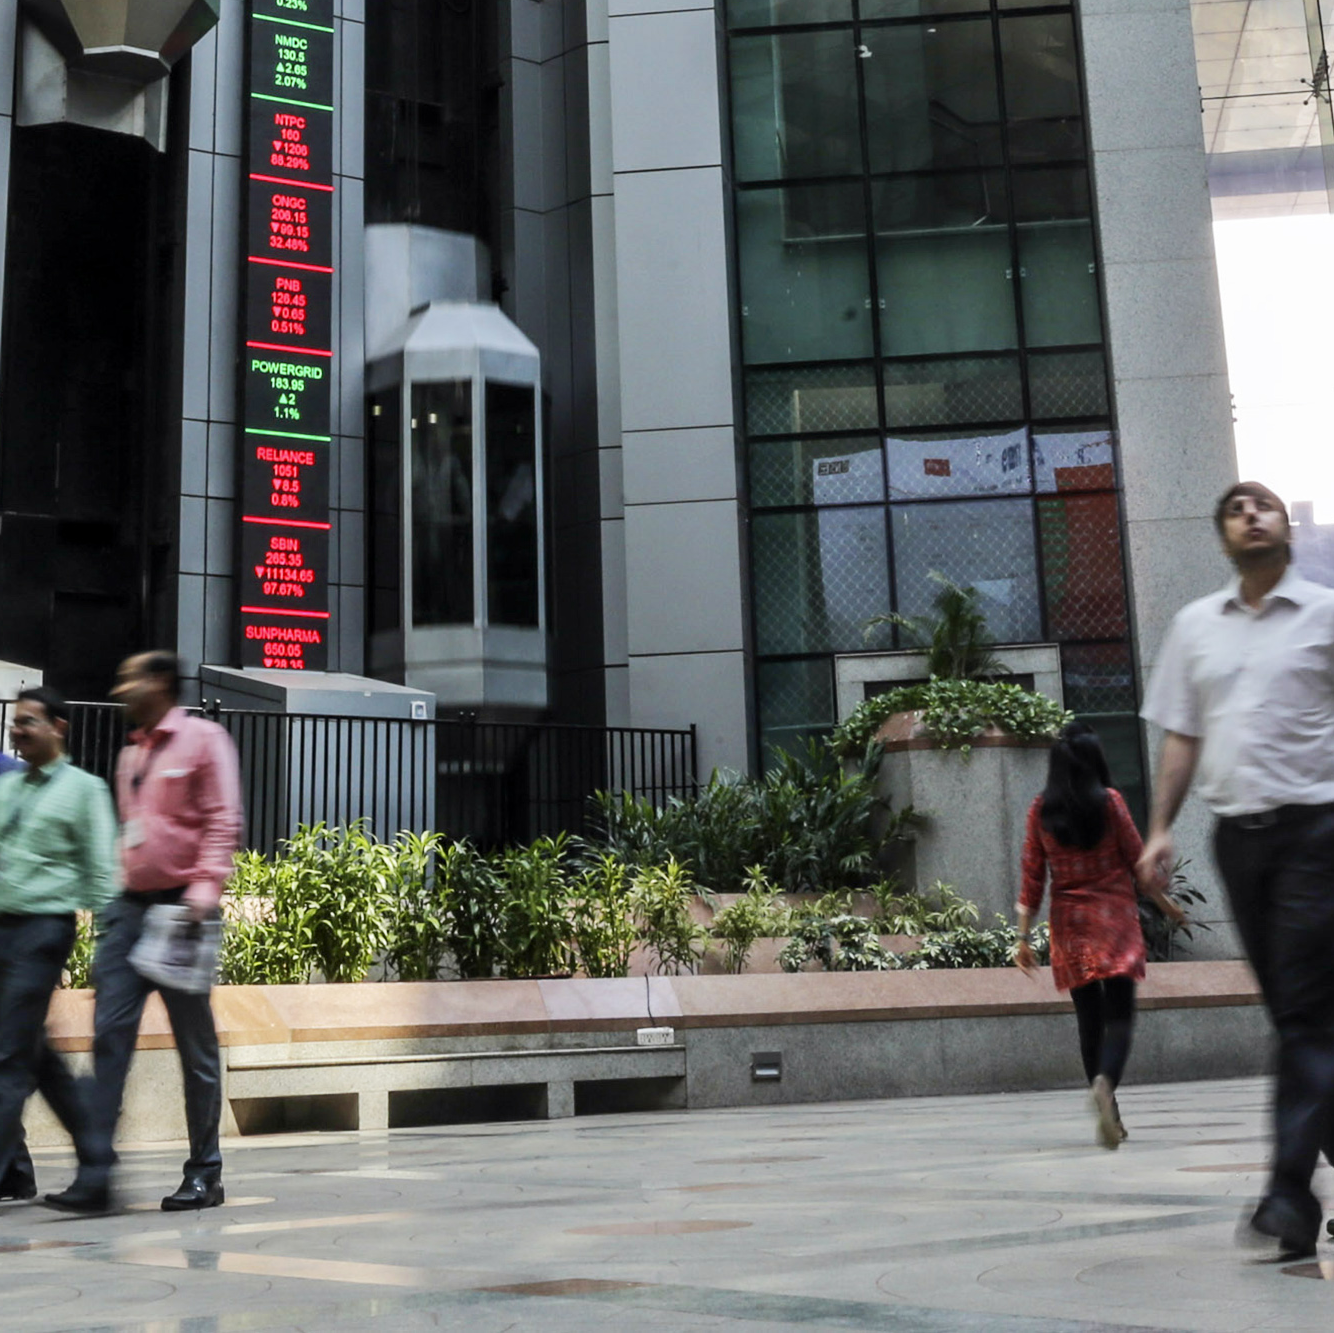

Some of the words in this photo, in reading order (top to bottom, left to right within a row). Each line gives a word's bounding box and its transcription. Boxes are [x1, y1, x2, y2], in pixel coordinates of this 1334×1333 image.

[274, 34, 308, 50] NMDC
[277, 48, 306, 62] 130.5
[285, 62, 308, 77] 2.65
[274, 73, 307, 89] 2.07%
[273, 113, 306, 129] NTPC
[271, 193, 307, 210] ONGC
[279, 221, 310, 238] 99.15
[274, 276, 302, 293] PNB
[281, 305, 306, 321] 0.65
[270, 318, 306, 334] 0.51%
[251, 362, 322, 379] POWERGRID
[270, 376, 305, 391] 183.95
[287, 392, 297, 405] 2
[272, 405, 301, 419] 1.1%
[256, 446, 315, 465] RELIANCE
[272, 463, 299, 478] 1051
[281, 478, 301, 493] 8.5
[269, 536, 300, 552] SBIN
[265, 567, 314, 582] 11134.65
[245, 626, 321, 643] SUNPHARMA
[264, 643, 302, 658] 650.05
